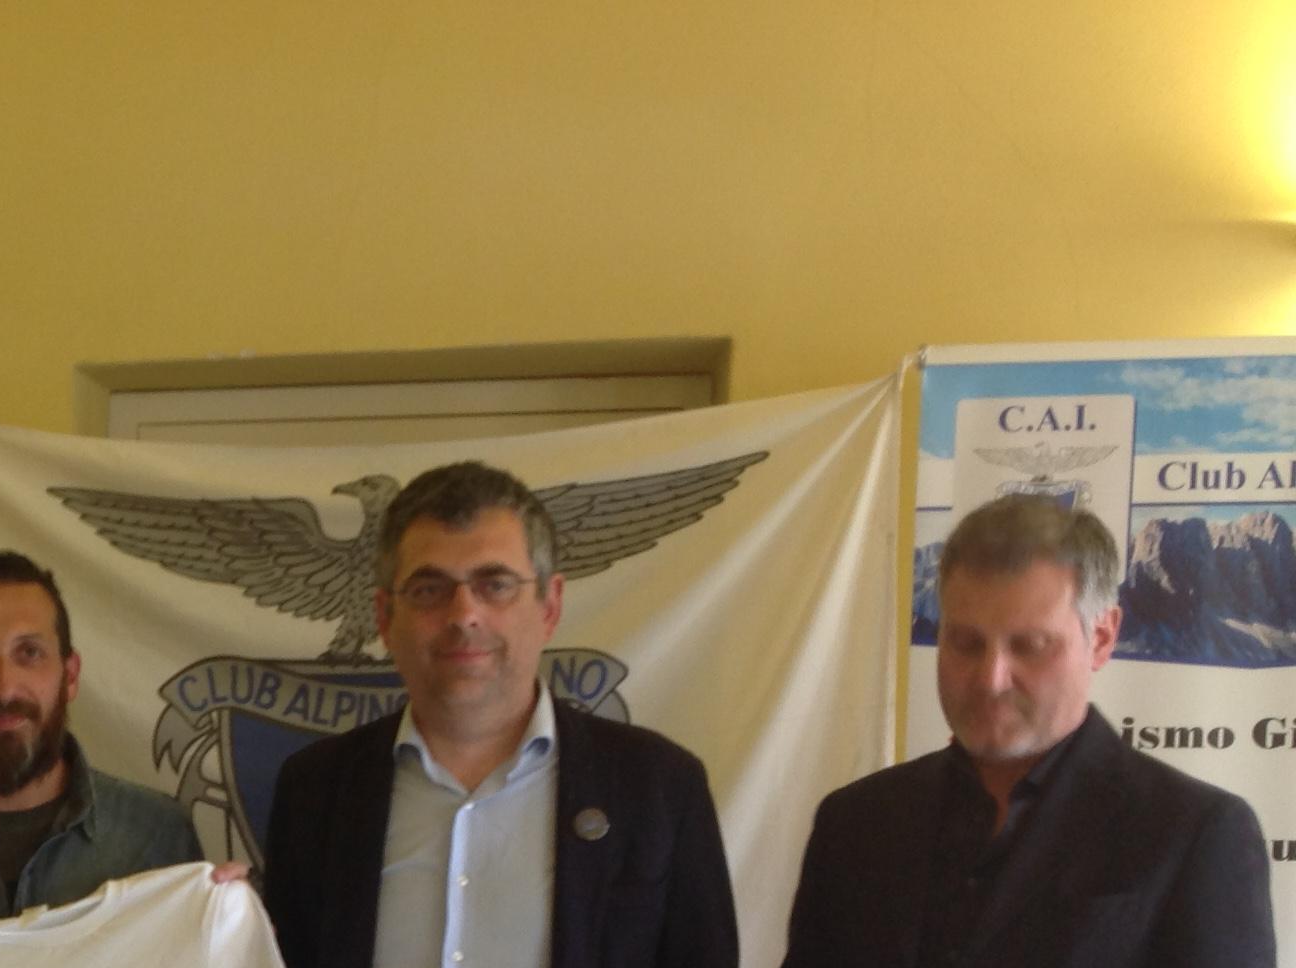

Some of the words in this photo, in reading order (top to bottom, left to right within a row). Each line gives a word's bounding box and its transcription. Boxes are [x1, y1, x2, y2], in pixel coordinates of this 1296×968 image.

[998, 404, 1097, 433] C.A.I.
[1157, 460, 1247, 491] Club
[177, 663, 282, 712] CLUB
